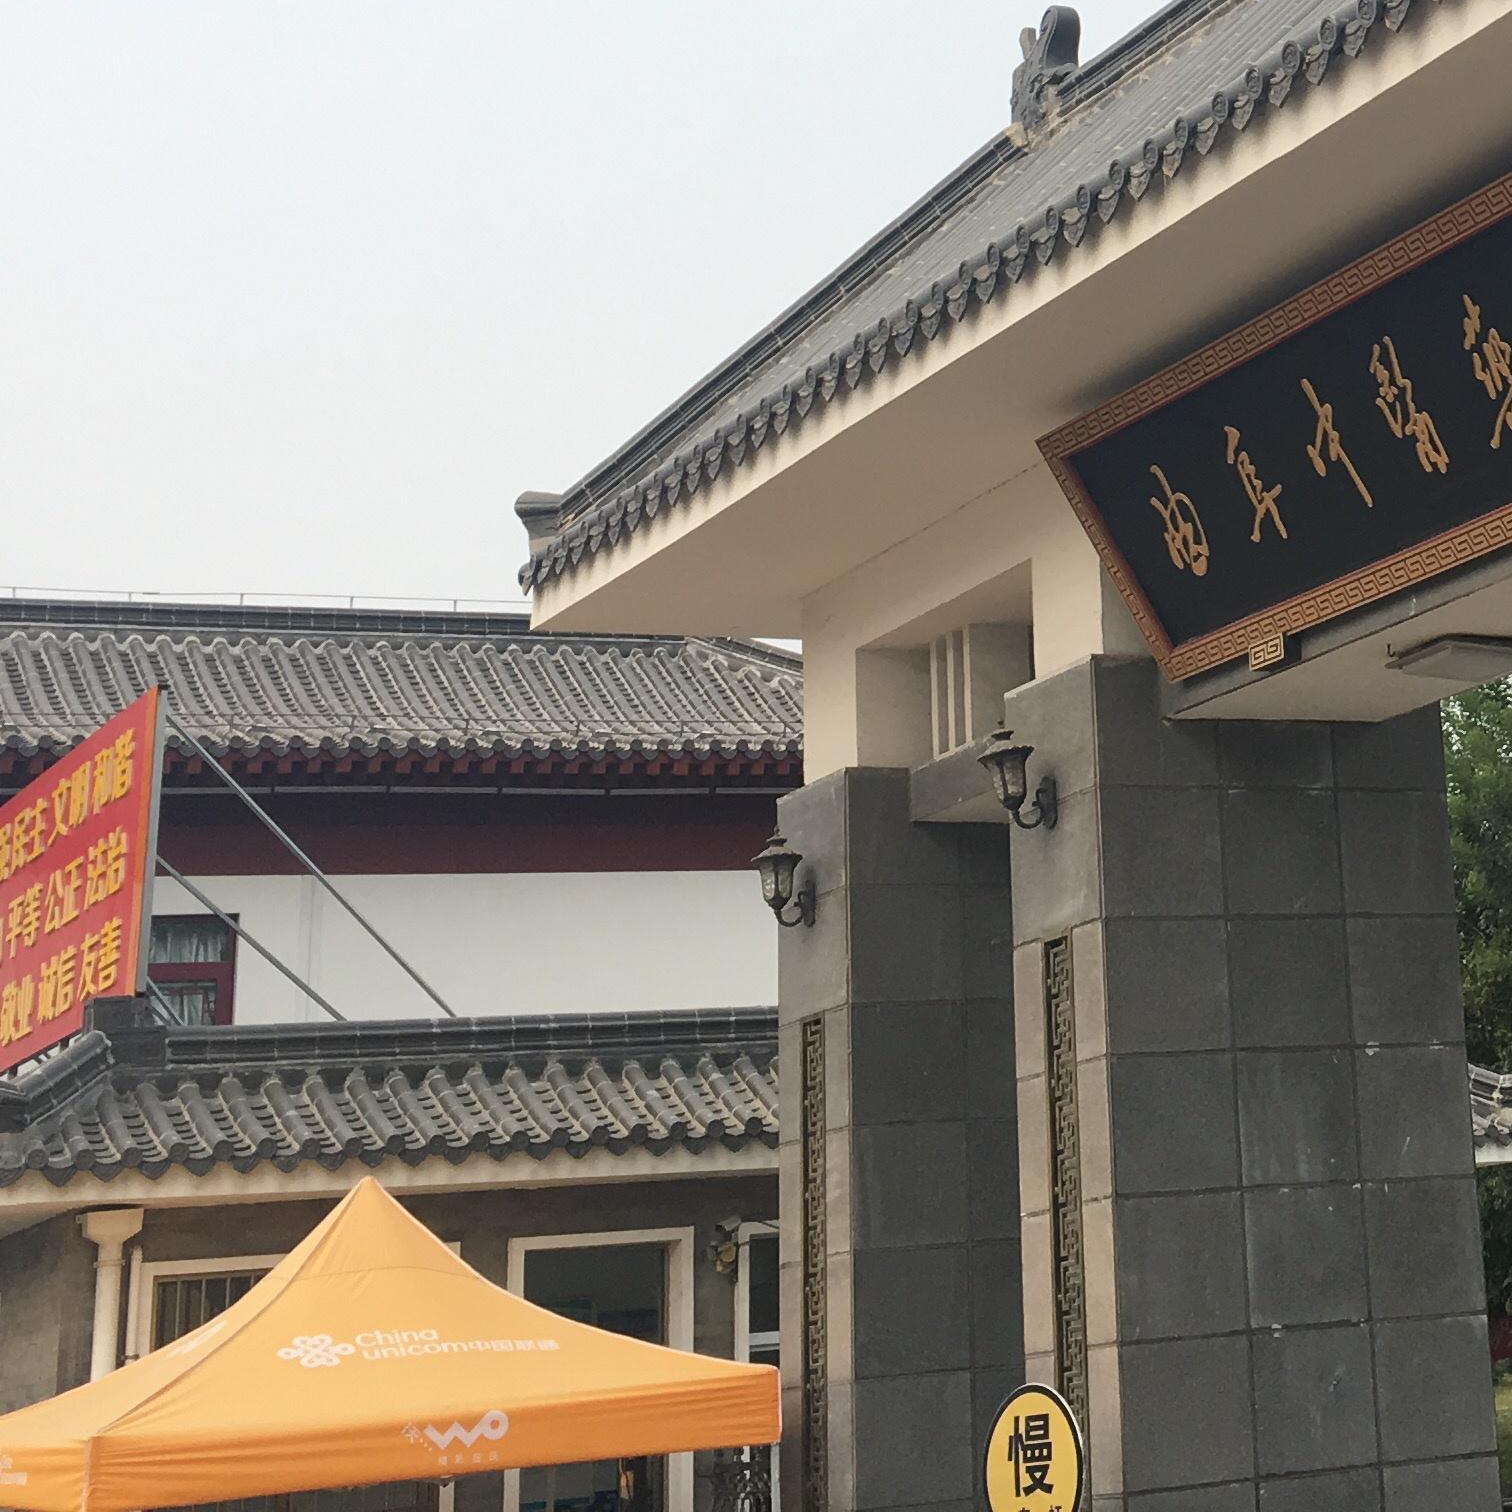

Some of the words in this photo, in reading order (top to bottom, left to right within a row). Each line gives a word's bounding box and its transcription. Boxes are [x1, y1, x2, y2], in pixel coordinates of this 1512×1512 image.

[355, 1329, 438, 1347] China
[362, 1341, 468, 1360] unicom
[1008, 1414, 1054, 1498] 慢
